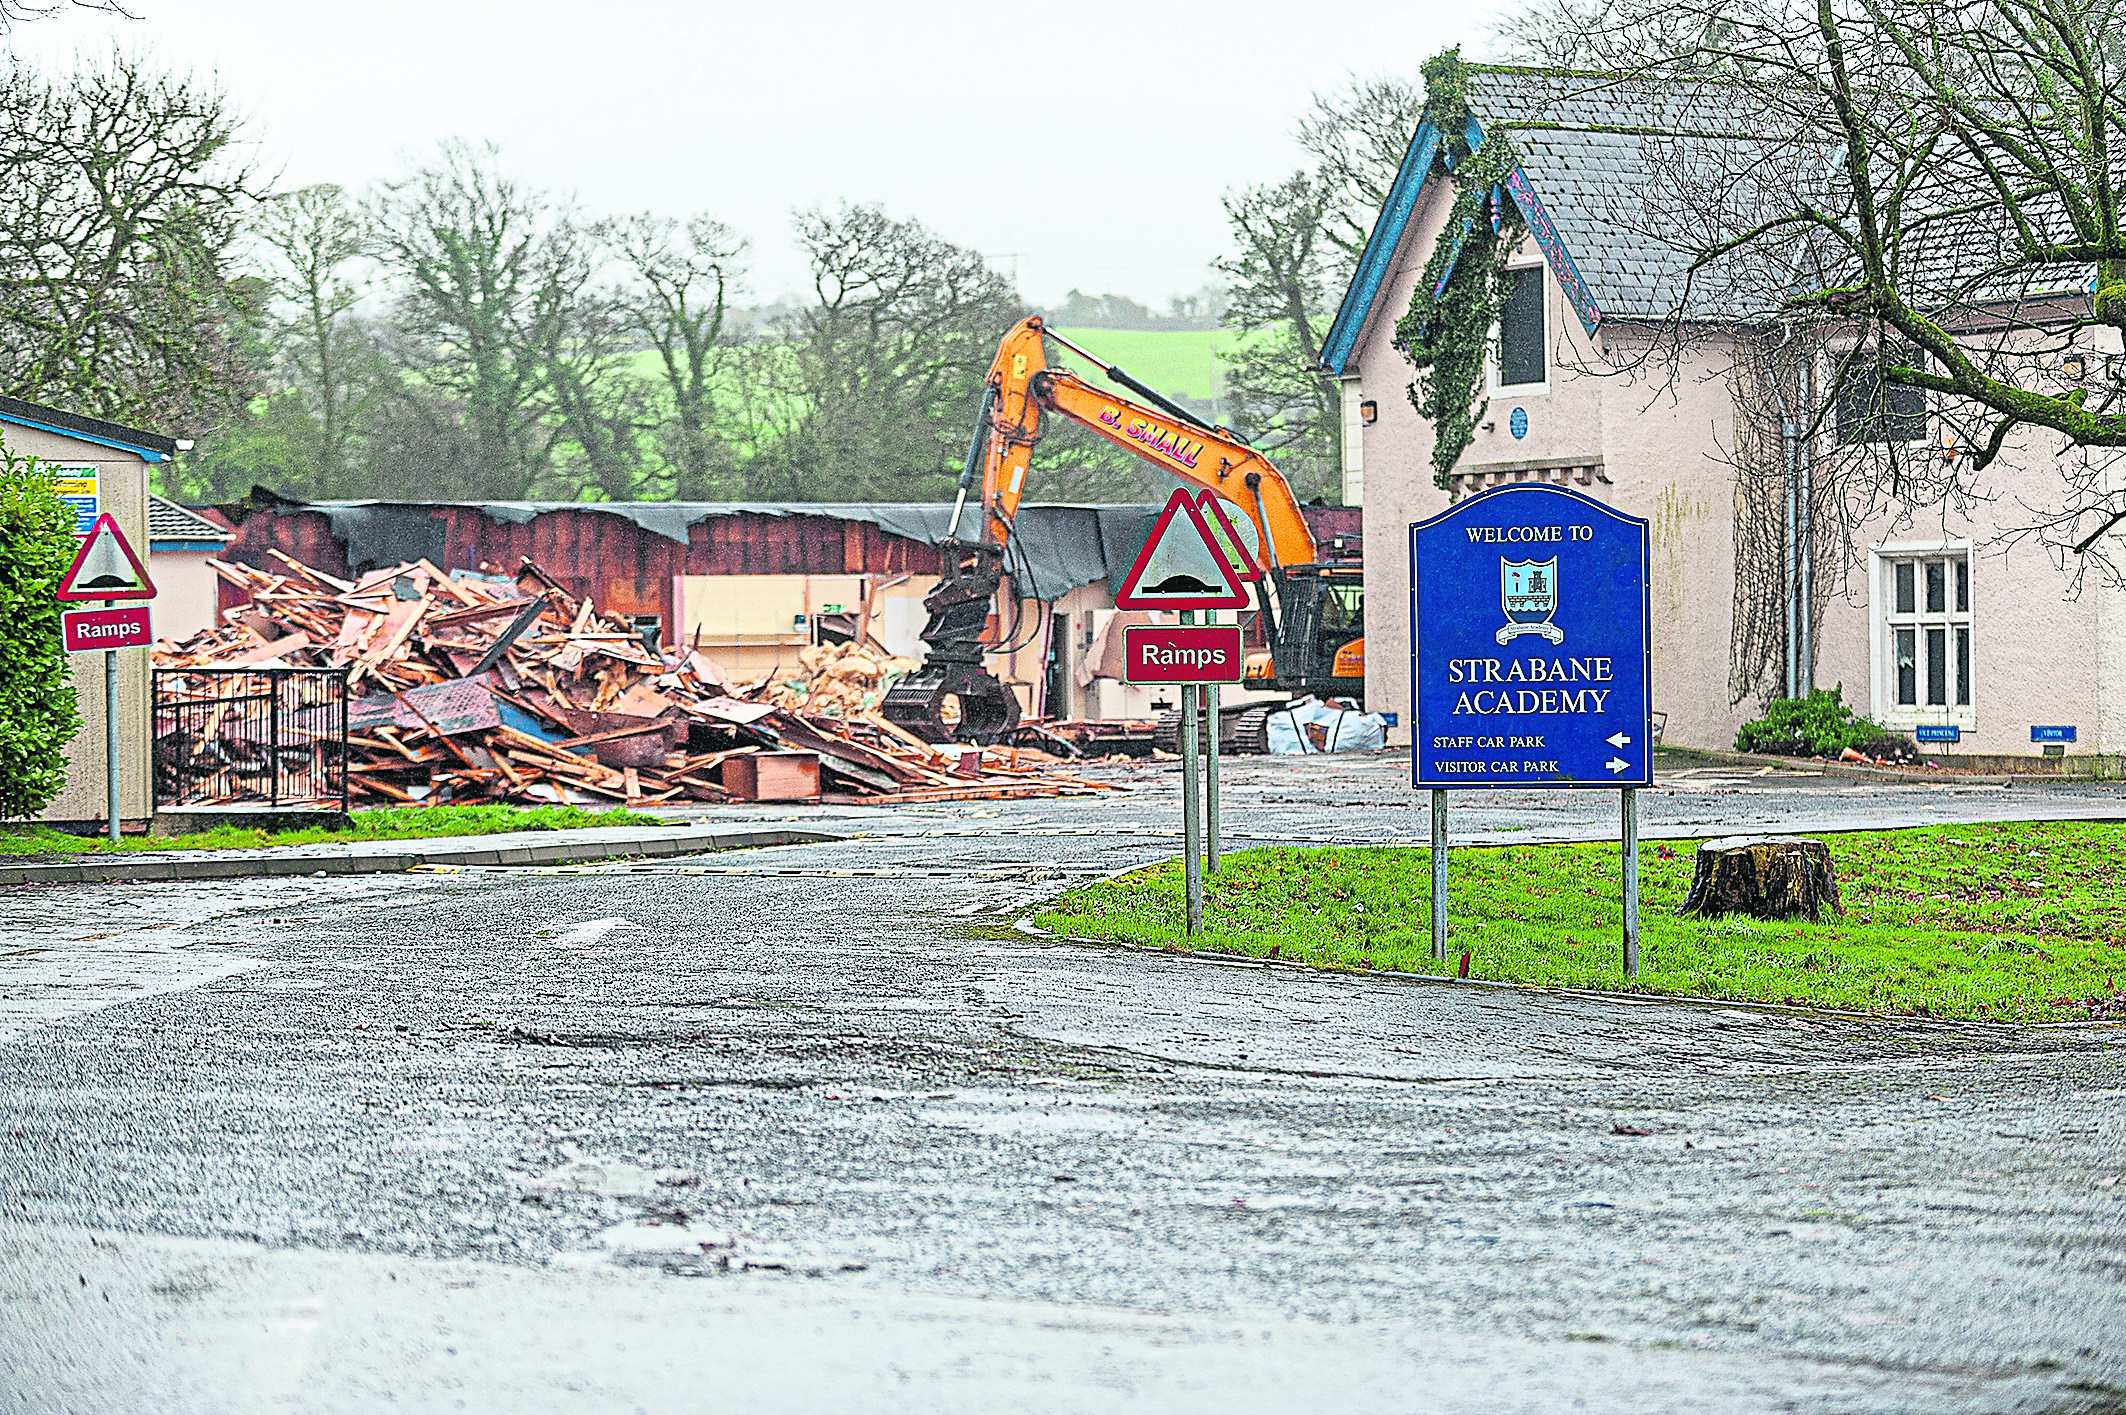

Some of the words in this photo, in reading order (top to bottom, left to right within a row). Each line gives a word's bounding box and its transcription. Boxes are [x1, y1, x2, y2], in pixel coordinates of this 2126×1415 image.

[1099, 406, 1122, 428] B.
[1125, 418, 1203, 467] SMALL
[1466, 527, 1563, 543] WELCOME
[1568, 526, 1594, 541] TO
[77, 621, 141, 640] Ramps
[1142, 644, 1226, 669] Ramps
[1449, 658, 1614, 683] STRABANE
[1453, 690, 1611, 715] ACADEMY
[1433, 737, 1473, 748] STAFF
[1477, 737, 1506, 748] CAR
[1509, 736, 1545, 748] PARK
[1435, 761, 1487, 773] VISITOR
[1490, 761, 1520, 772] CAR
[1523, 761, 1559, 772] PARK
